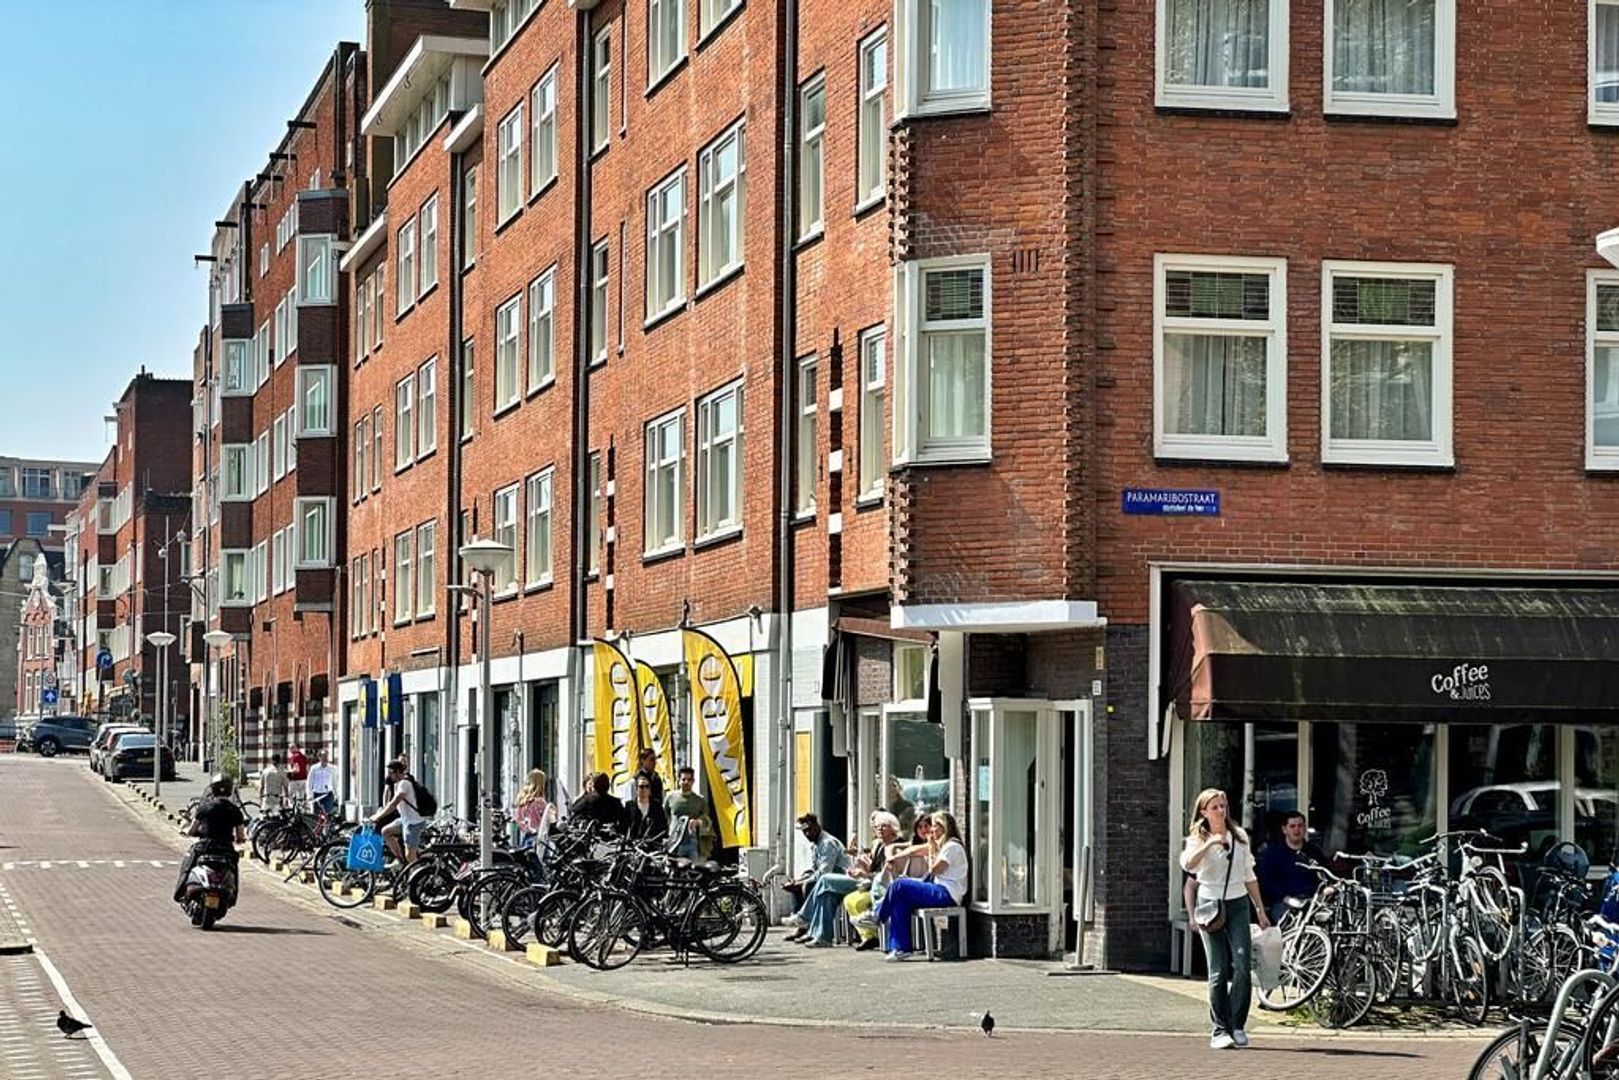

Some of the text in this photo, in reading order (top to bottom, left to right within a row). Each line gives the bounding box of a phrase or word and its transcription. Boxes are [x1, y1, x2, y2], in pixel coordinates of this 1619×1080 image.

[1127, 491, 1215, 504] PARAMARIBOSTRAAT
[1431, 663, 1489, 693] Coffee
[1357, 806, 1392, 825] Coffee
